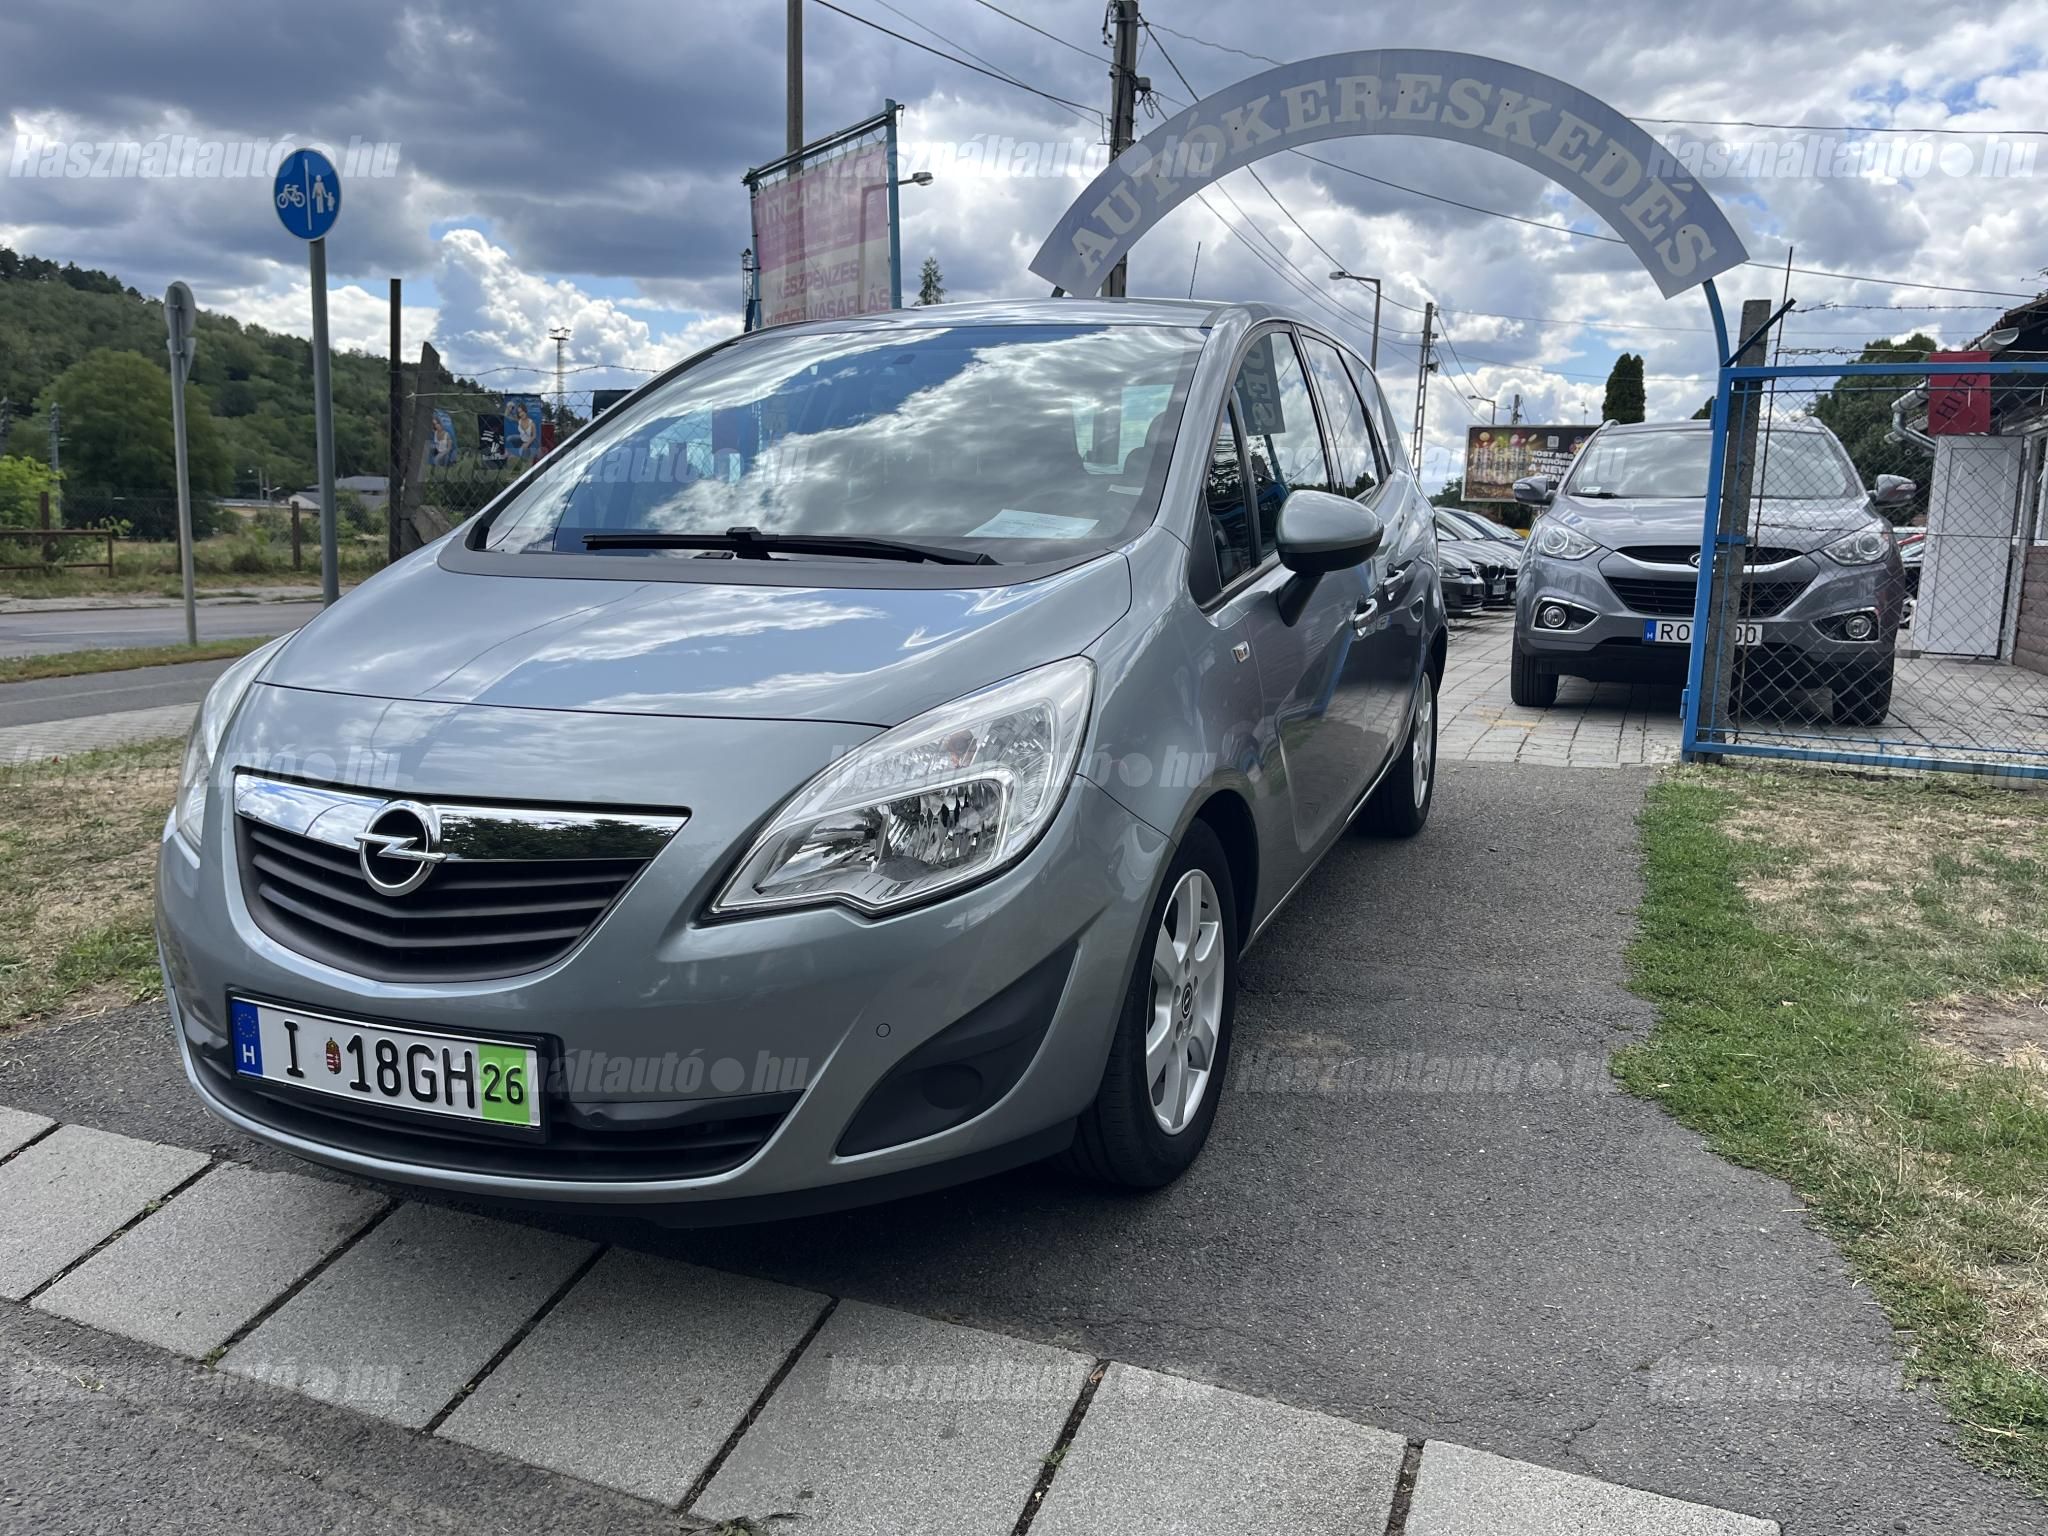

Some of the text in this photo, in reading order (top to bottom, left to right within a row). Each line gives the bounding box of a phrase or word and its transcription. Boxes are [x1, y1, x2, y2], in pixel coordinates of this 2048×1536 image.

[1071, 72, 1716, 280] AUTÓKERESKEDÉS
[1936, 374, 1979, 420] HITE
[241, 1019, 524, 1110] H I 18GH 26
